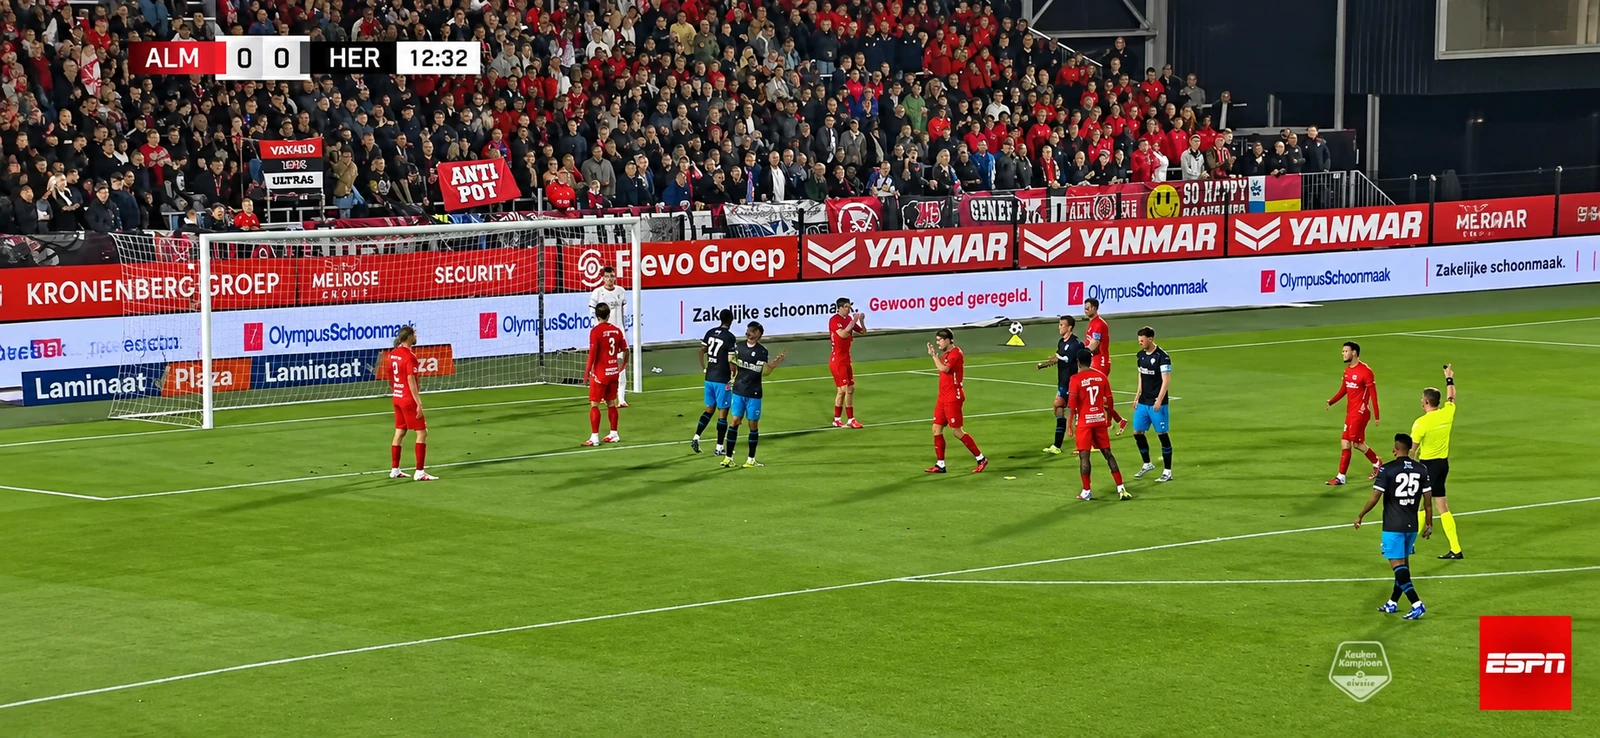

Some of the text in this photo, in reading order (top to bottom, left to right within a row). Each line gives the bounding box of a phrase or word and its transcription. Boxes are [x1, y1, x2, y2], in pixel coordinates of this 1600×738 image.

[272, 175, 314, 185] ULTRAS
[450, 162, 500, 186] ANTI
[458, 181, 498, 203] POT
[1183, 179, 1248, 204] SO HAPPY
[1079, 221, 1218, 257] YANMAR
[1289, 210, 1423, 246] YANMAR
[616, 244, 785, 278] Fevo Groep
[864, 232, 1008, 268] YANMAR
[434, 263, 516, 285] SECURITY
[1280, 267, 1391, 290] OlympusSchoonmaak
[1436, 255, 1566, 278] Zakelijke schoonmaak.
[27, 272, 280, 306] KRONENBERG GROEP
[312, 270, 379, 289] MELROSE
[1088, 278, 1208, 302] OlympusSchoonmaak
[692, 287, 1032, 323] Zaklijke schoonma. Gewoon goed geregeld.
[269, 319, 417, 347] OlympusSchoonma
[608, 337, 616, 356] 3
[707, 336, 724, 357] 27
[35, 372, 147, 400] Laminaat
[265, 357, 362, 383] Laminaat
[1086, 385, 1100, 406] 17
[1394, 472, 1421, 497] 25
